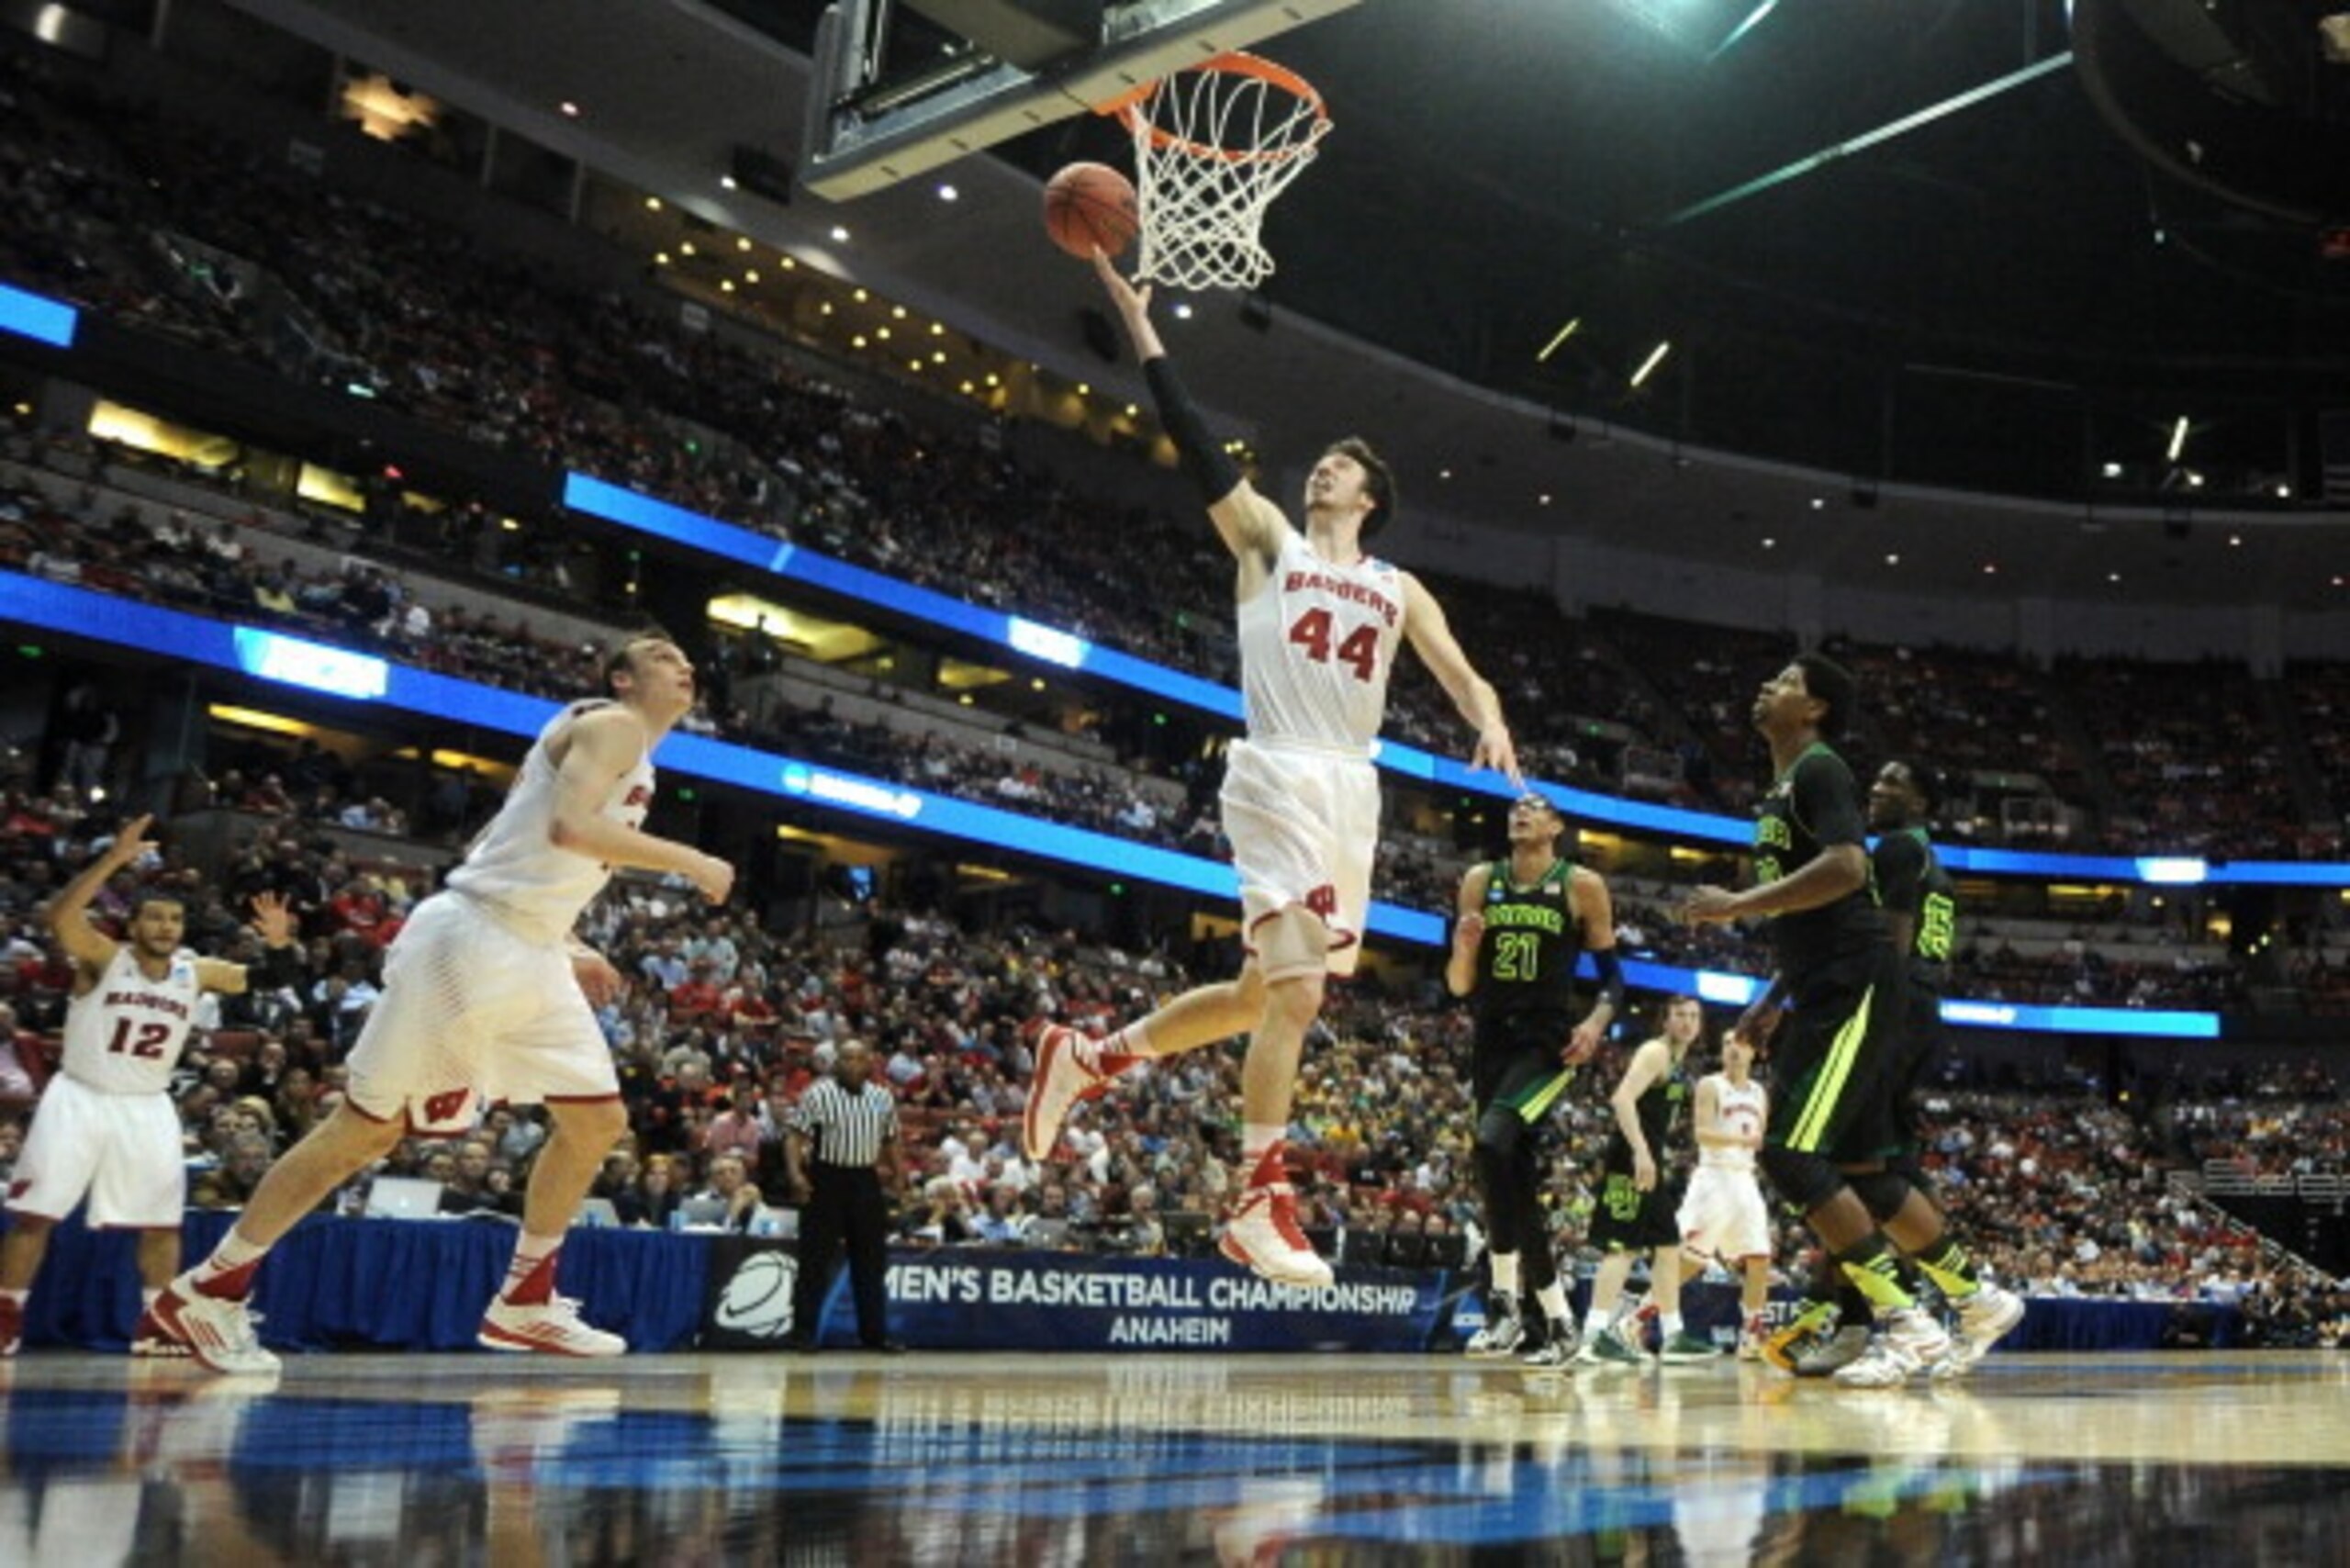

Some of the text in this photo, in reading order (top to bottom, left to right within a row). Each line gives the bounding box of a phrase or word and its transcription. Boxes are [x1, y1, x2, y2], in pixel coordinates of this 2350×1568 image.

[1289, 606, 1379, 683] 44
[1492, 931, 1540, 982] 21
[107, 1014, 172, 1059] 12
[989, 1269, 1201, 1308] BASKETBALL
[1208, 1276, 1418, 1315] CHAMPIONSHIP
[1107, 1316, 1232, 1344] ANAHEIM
